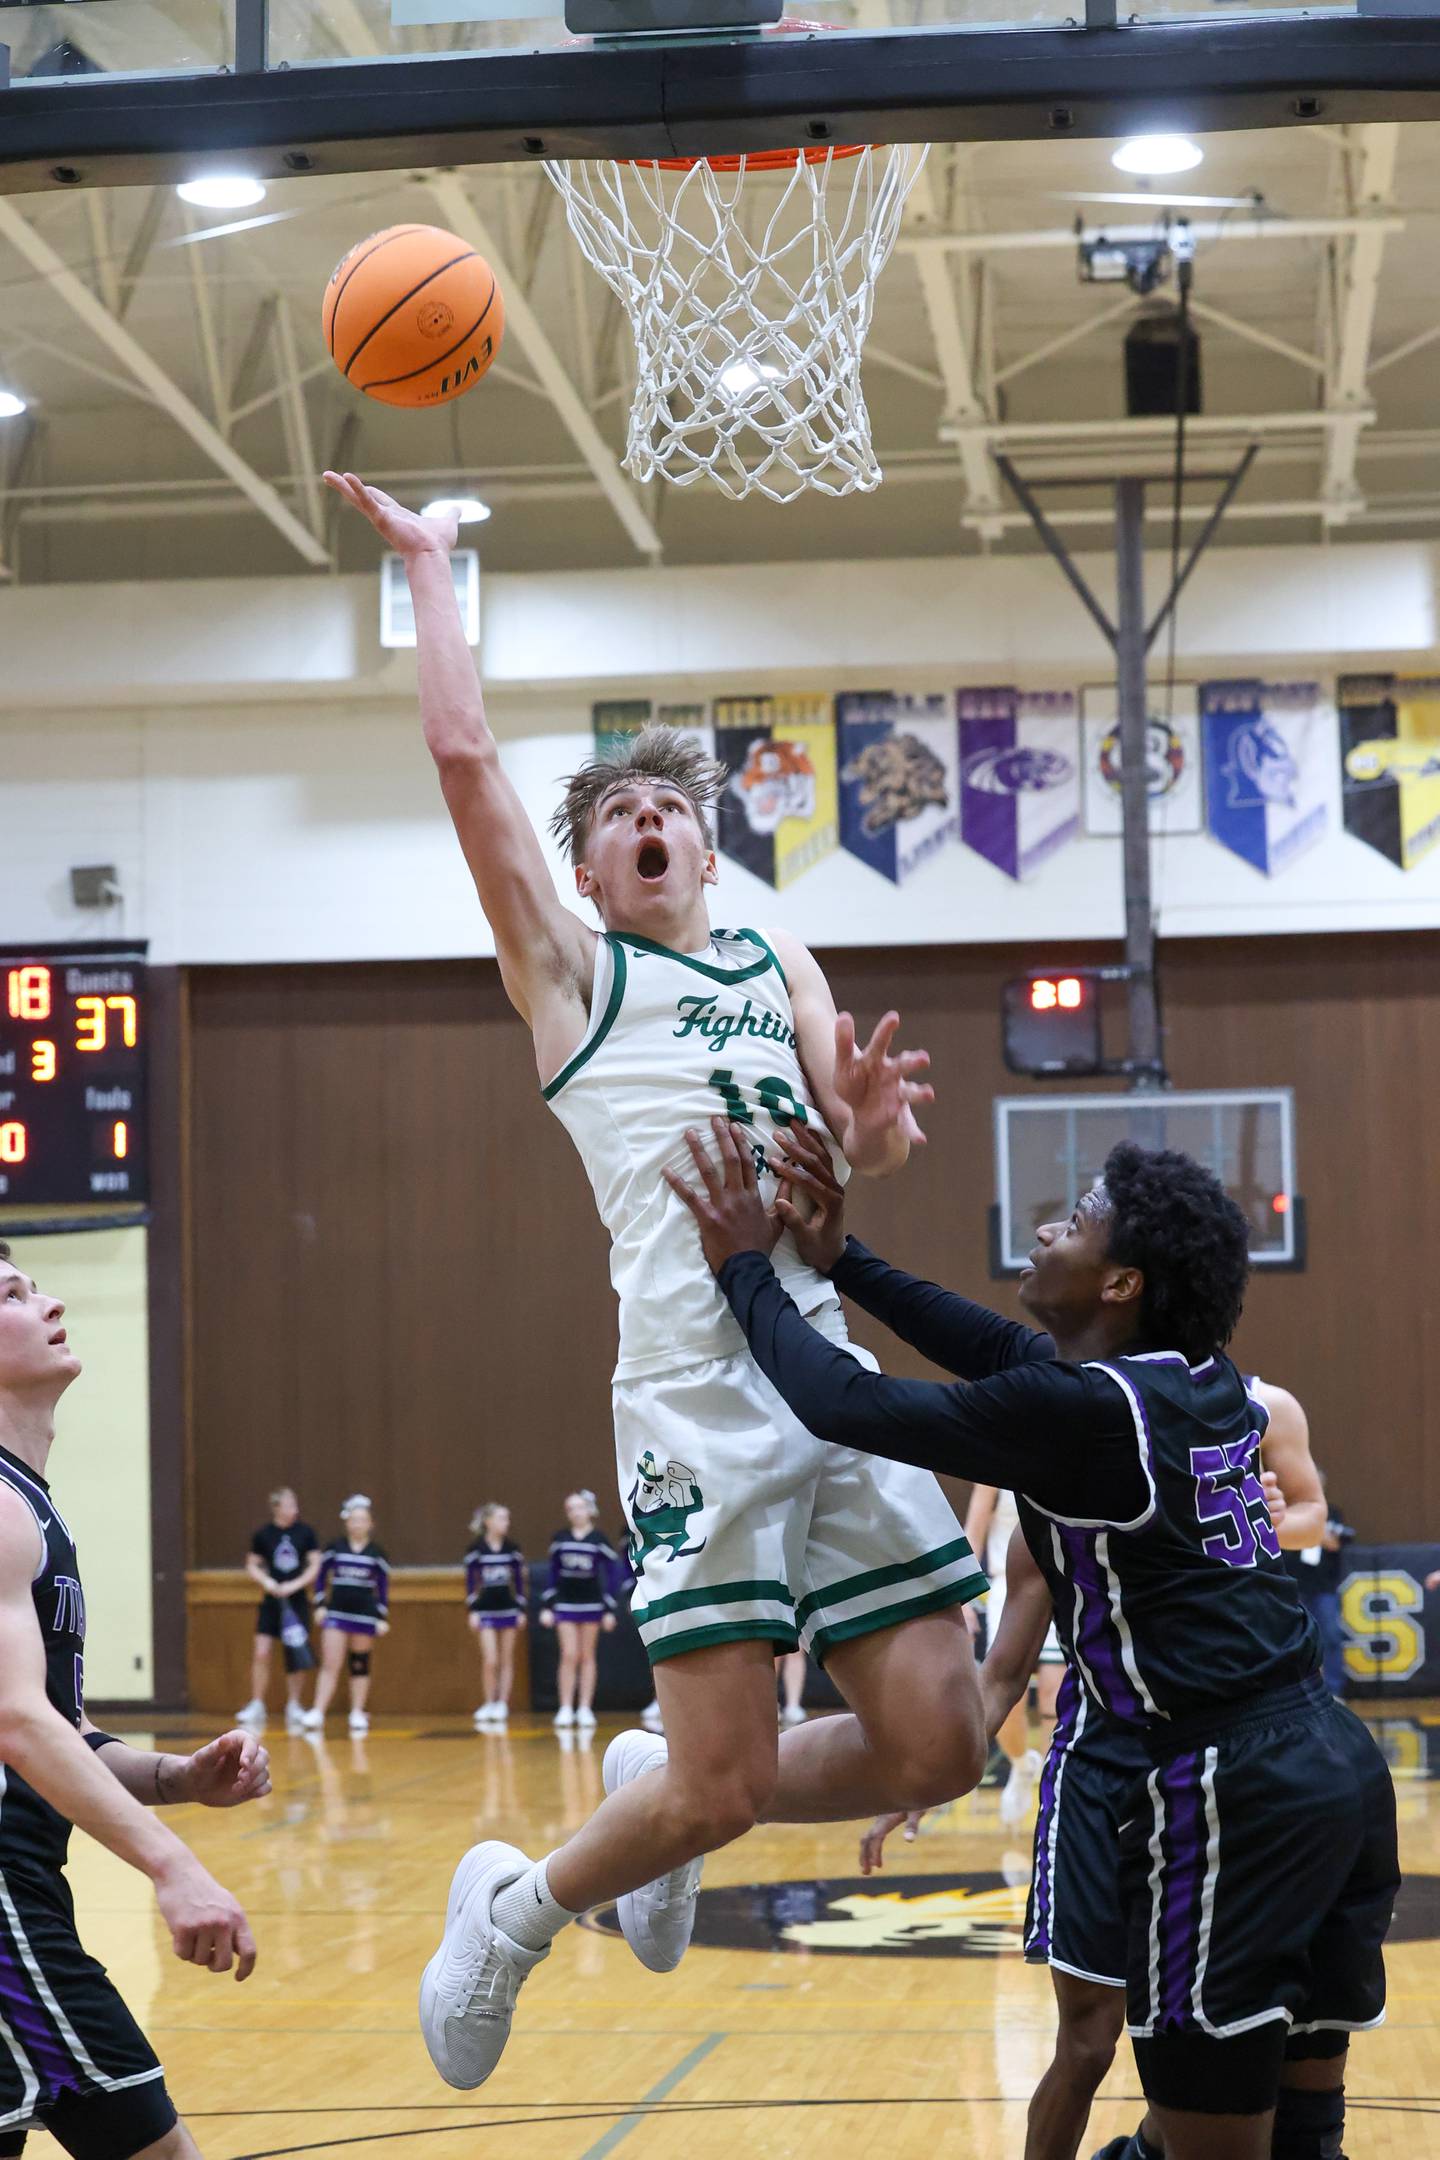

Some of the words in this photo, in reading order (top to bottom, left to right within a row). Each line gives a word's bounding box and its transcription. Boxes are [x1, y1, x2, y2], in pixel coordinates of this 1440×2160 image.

[75, 996, 137, 1052] 37
[31, 1039, 56, 1082] 3
[113, 1121, 127, 1159] 1
[1189, 1430, 1282, 1568] 55
[1337, 1569, 1426, 1682] S
